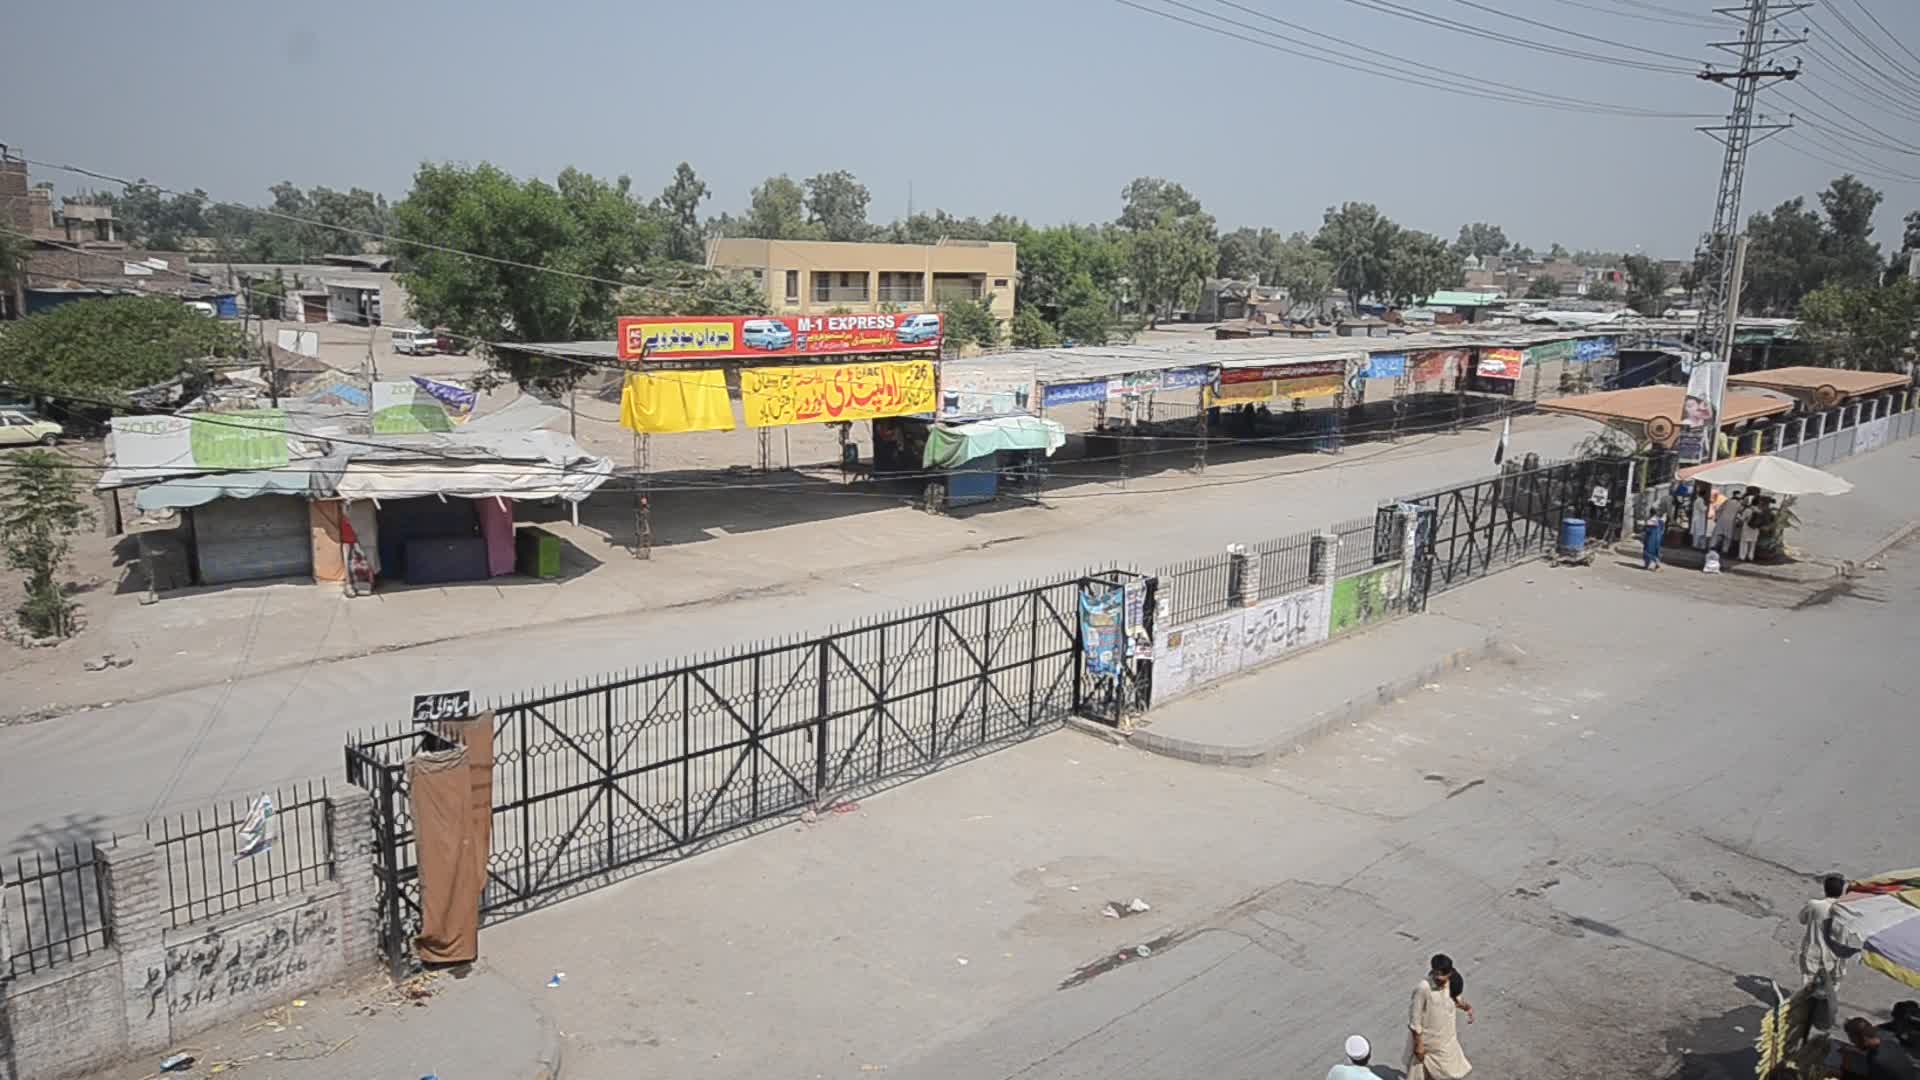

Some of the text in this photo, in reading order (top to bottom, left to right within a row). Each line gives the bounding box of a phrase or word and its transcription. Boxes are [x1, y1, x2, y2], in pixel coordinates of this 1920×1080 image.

[798, 316, 896, 331] M-1 EXPRESS
[913, 364, 928, 381] 26
[825, 367, 904, 418] راولپنڈی
